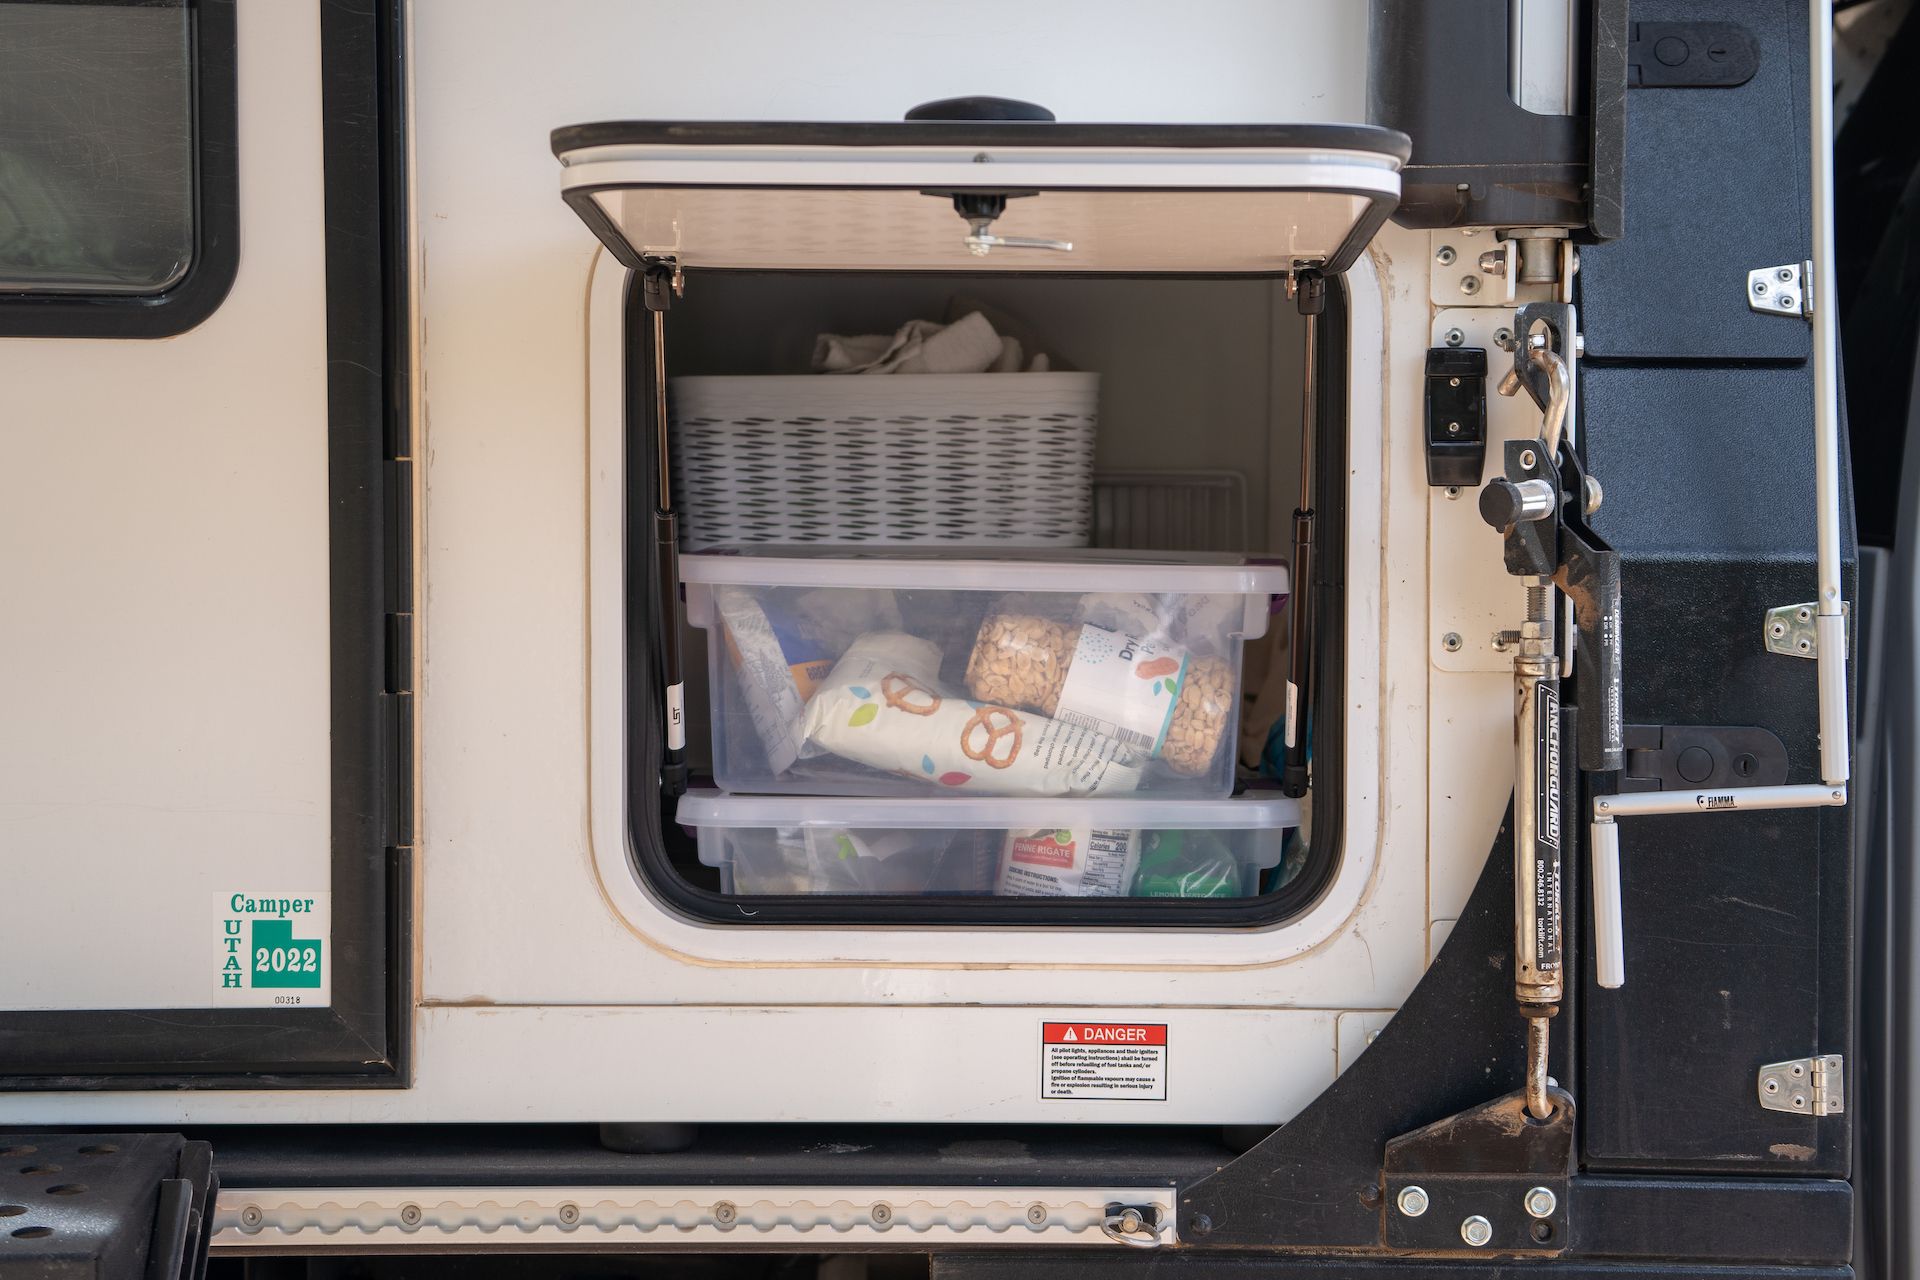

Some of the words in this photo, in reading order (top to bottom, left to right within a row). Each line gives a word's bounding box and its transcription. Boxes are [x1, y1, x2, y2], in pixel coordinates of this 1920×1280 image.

[1118, 639, 1139, 661] Dry
[1044, 742, 1054, 770] chomped
[1550, 702, 1559, 836] ANCHORGUARD
[1708, 796, 1734, 807] FIAMMA
[1015, 843, 1036, 853] PENNE
[1037, 845, 1070, 858] RIGATE
[1090, 841, 1110, 849] Calories
[1116, 842, 1127, 851] 200
[231, 893, 314, 918] Camper
[222, 920, 242, 988] UTAH
[256, 948, 316, 972] 2022
[1084, 1028, 1146, 1040] DANGER
